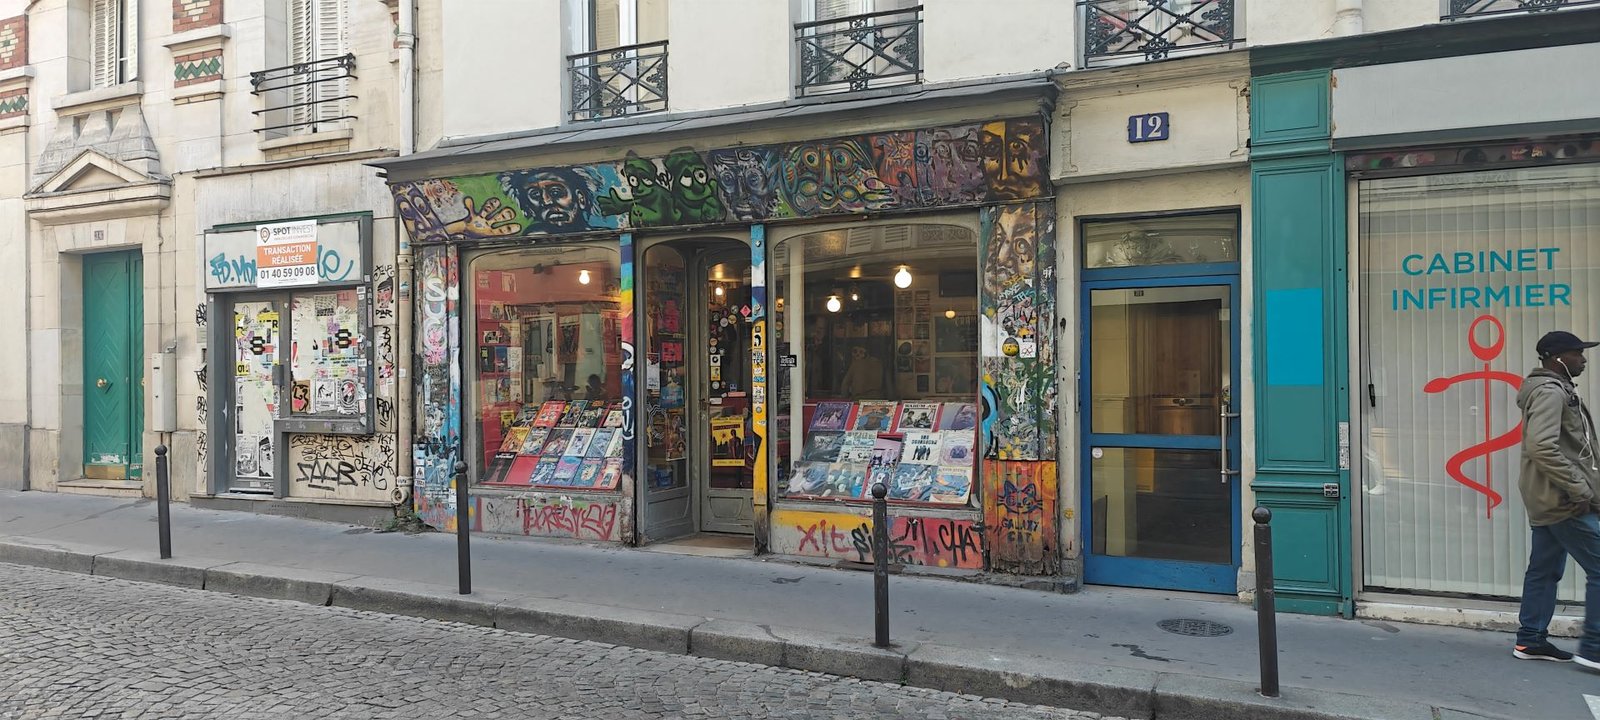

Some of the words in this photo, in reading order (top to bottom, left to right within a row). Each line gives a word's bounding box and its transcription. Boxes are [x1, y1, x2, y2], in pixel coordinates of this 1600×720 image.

[1135, 115, 1162, 139] 12
[263, 244, 311, 256] TRANSACTION
[271, 254, 304, 265] RÉALISÉE
[1402, 247, 1561, 276] CABINET
[260, 270, 270, 279] 01
[271, 269, 281, 278] 40
[282, 268, 292, 277] 59
[294, 267, 304, 276] 09
[305, 266, 315, 276] 08
[1392, 283, 1571, 311] INFIRMIER
